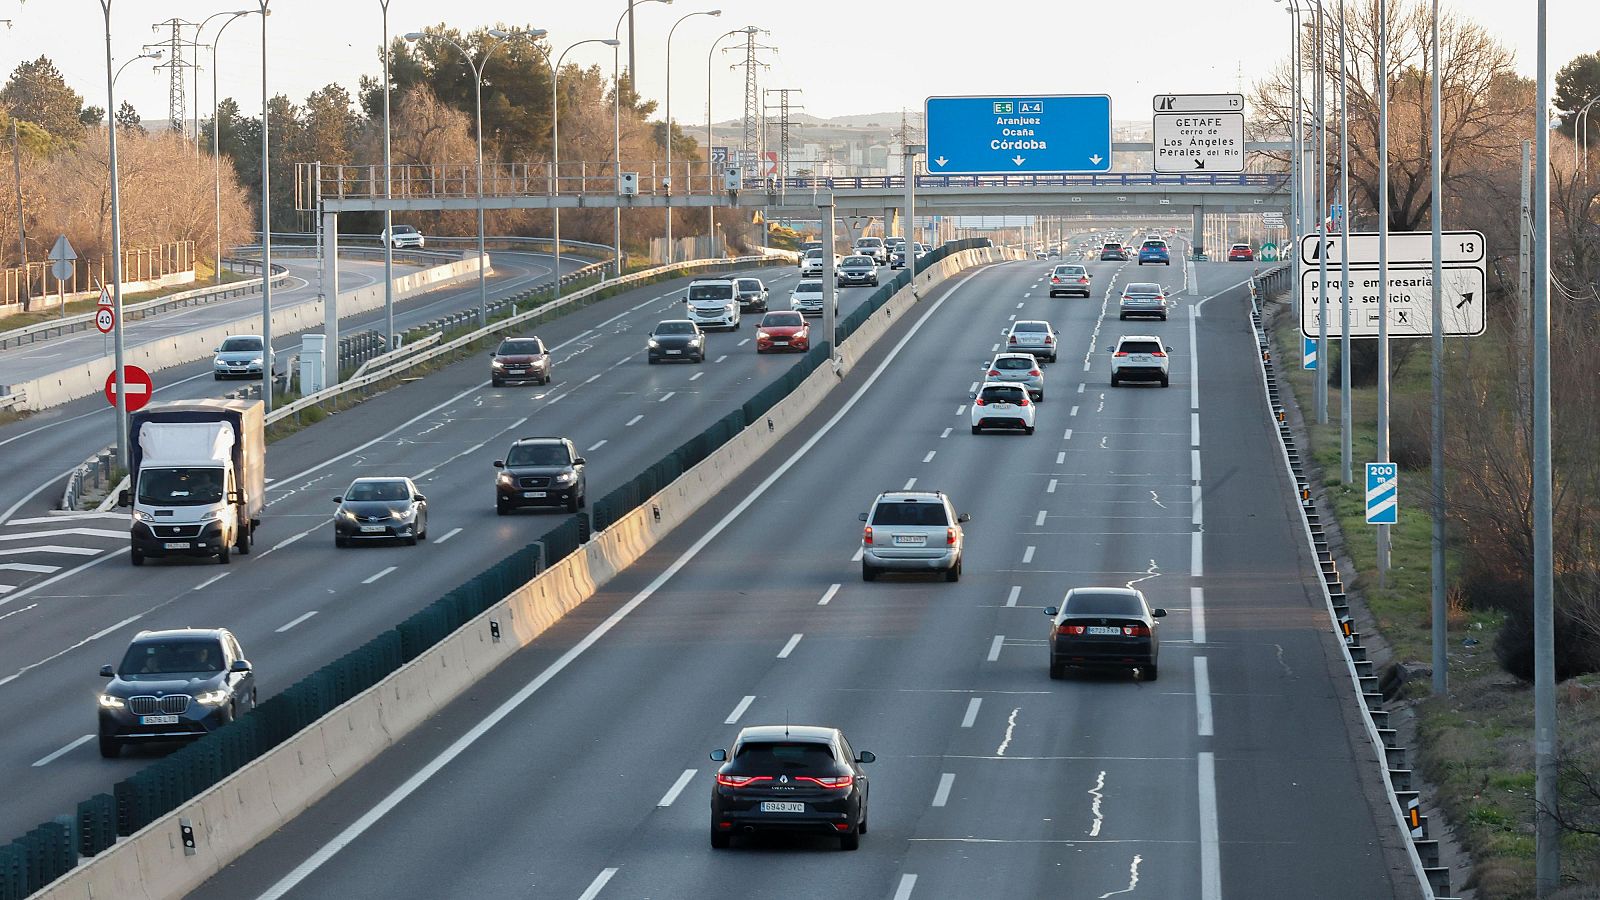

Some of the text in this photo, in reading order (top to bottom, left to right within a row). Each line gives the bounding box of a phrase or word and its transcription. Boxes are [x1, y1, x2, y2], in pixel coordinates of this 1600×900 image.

[995, 103, 1041, 112] E-5 A-4
[1229, 99, 1238, 107] 13
[996, 116, 1041, 126] Aranjuez
[1176, 118, 1222, 127] GETAFE
[1002, 128, 1035, 137] Ocaña
[990, 139, 1047, 150] Córdoba
[1163, 135, 1234, 147] Los Ángeles
[1159, 148, 1201, 156] Perales
[1459, 242, 1474, 253] 13
[1311, 279, 1354, 291] prqe
[1362, 293, 1411, 304] sericio
[99, 315, 111, 324] 40
[1370, 466, 1393, 476] 200
[765, 803, 802, 812] 6949 JVC
